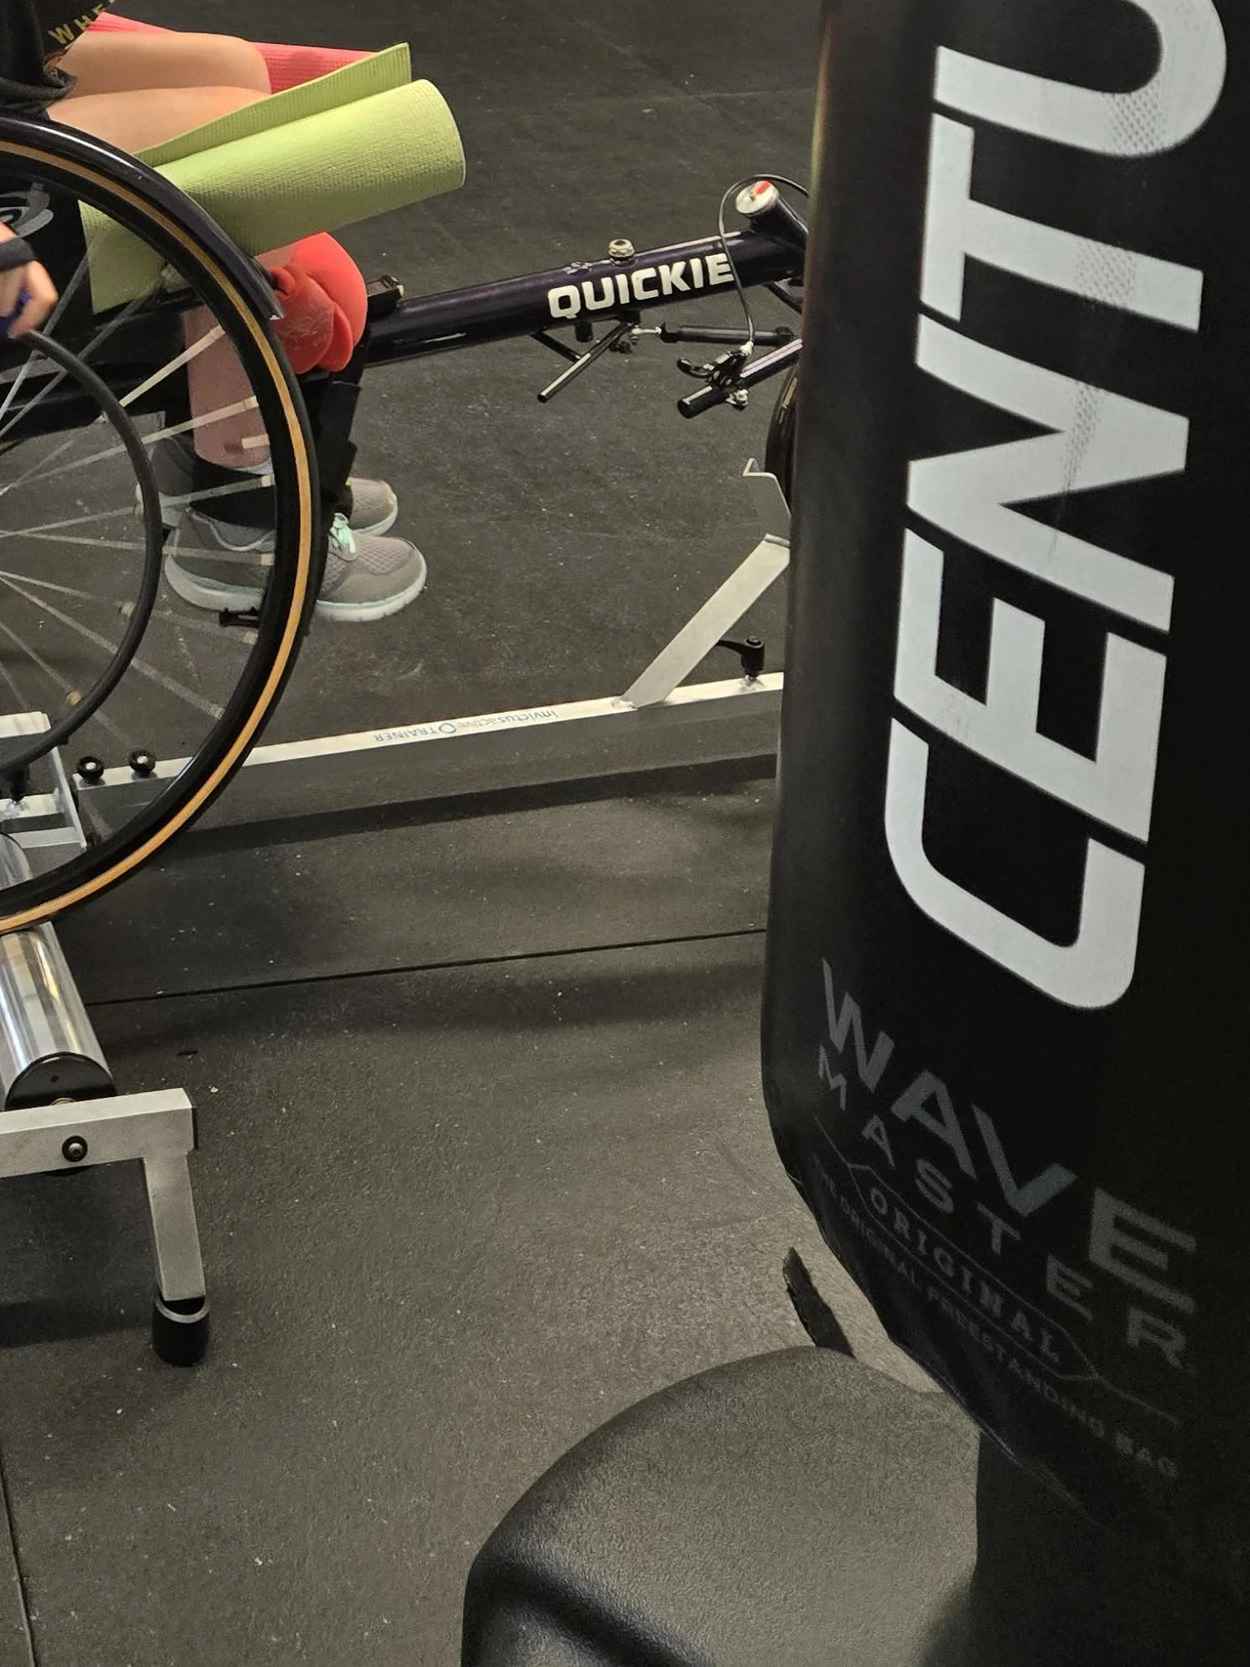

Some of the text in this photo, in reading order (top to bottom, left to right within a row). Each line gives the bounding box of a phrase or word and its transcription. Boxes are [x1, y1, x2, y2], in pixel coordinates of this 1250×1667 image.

[547, 252, 735, 320] QUICKIE
[374, 727, 440, 742] TRAINER
[817, 1045, 1187, 1369] MASTER
[821, 957, 1198, 1316] WAVE
[869, 1185, 1061, 1364] ORIGINAL
